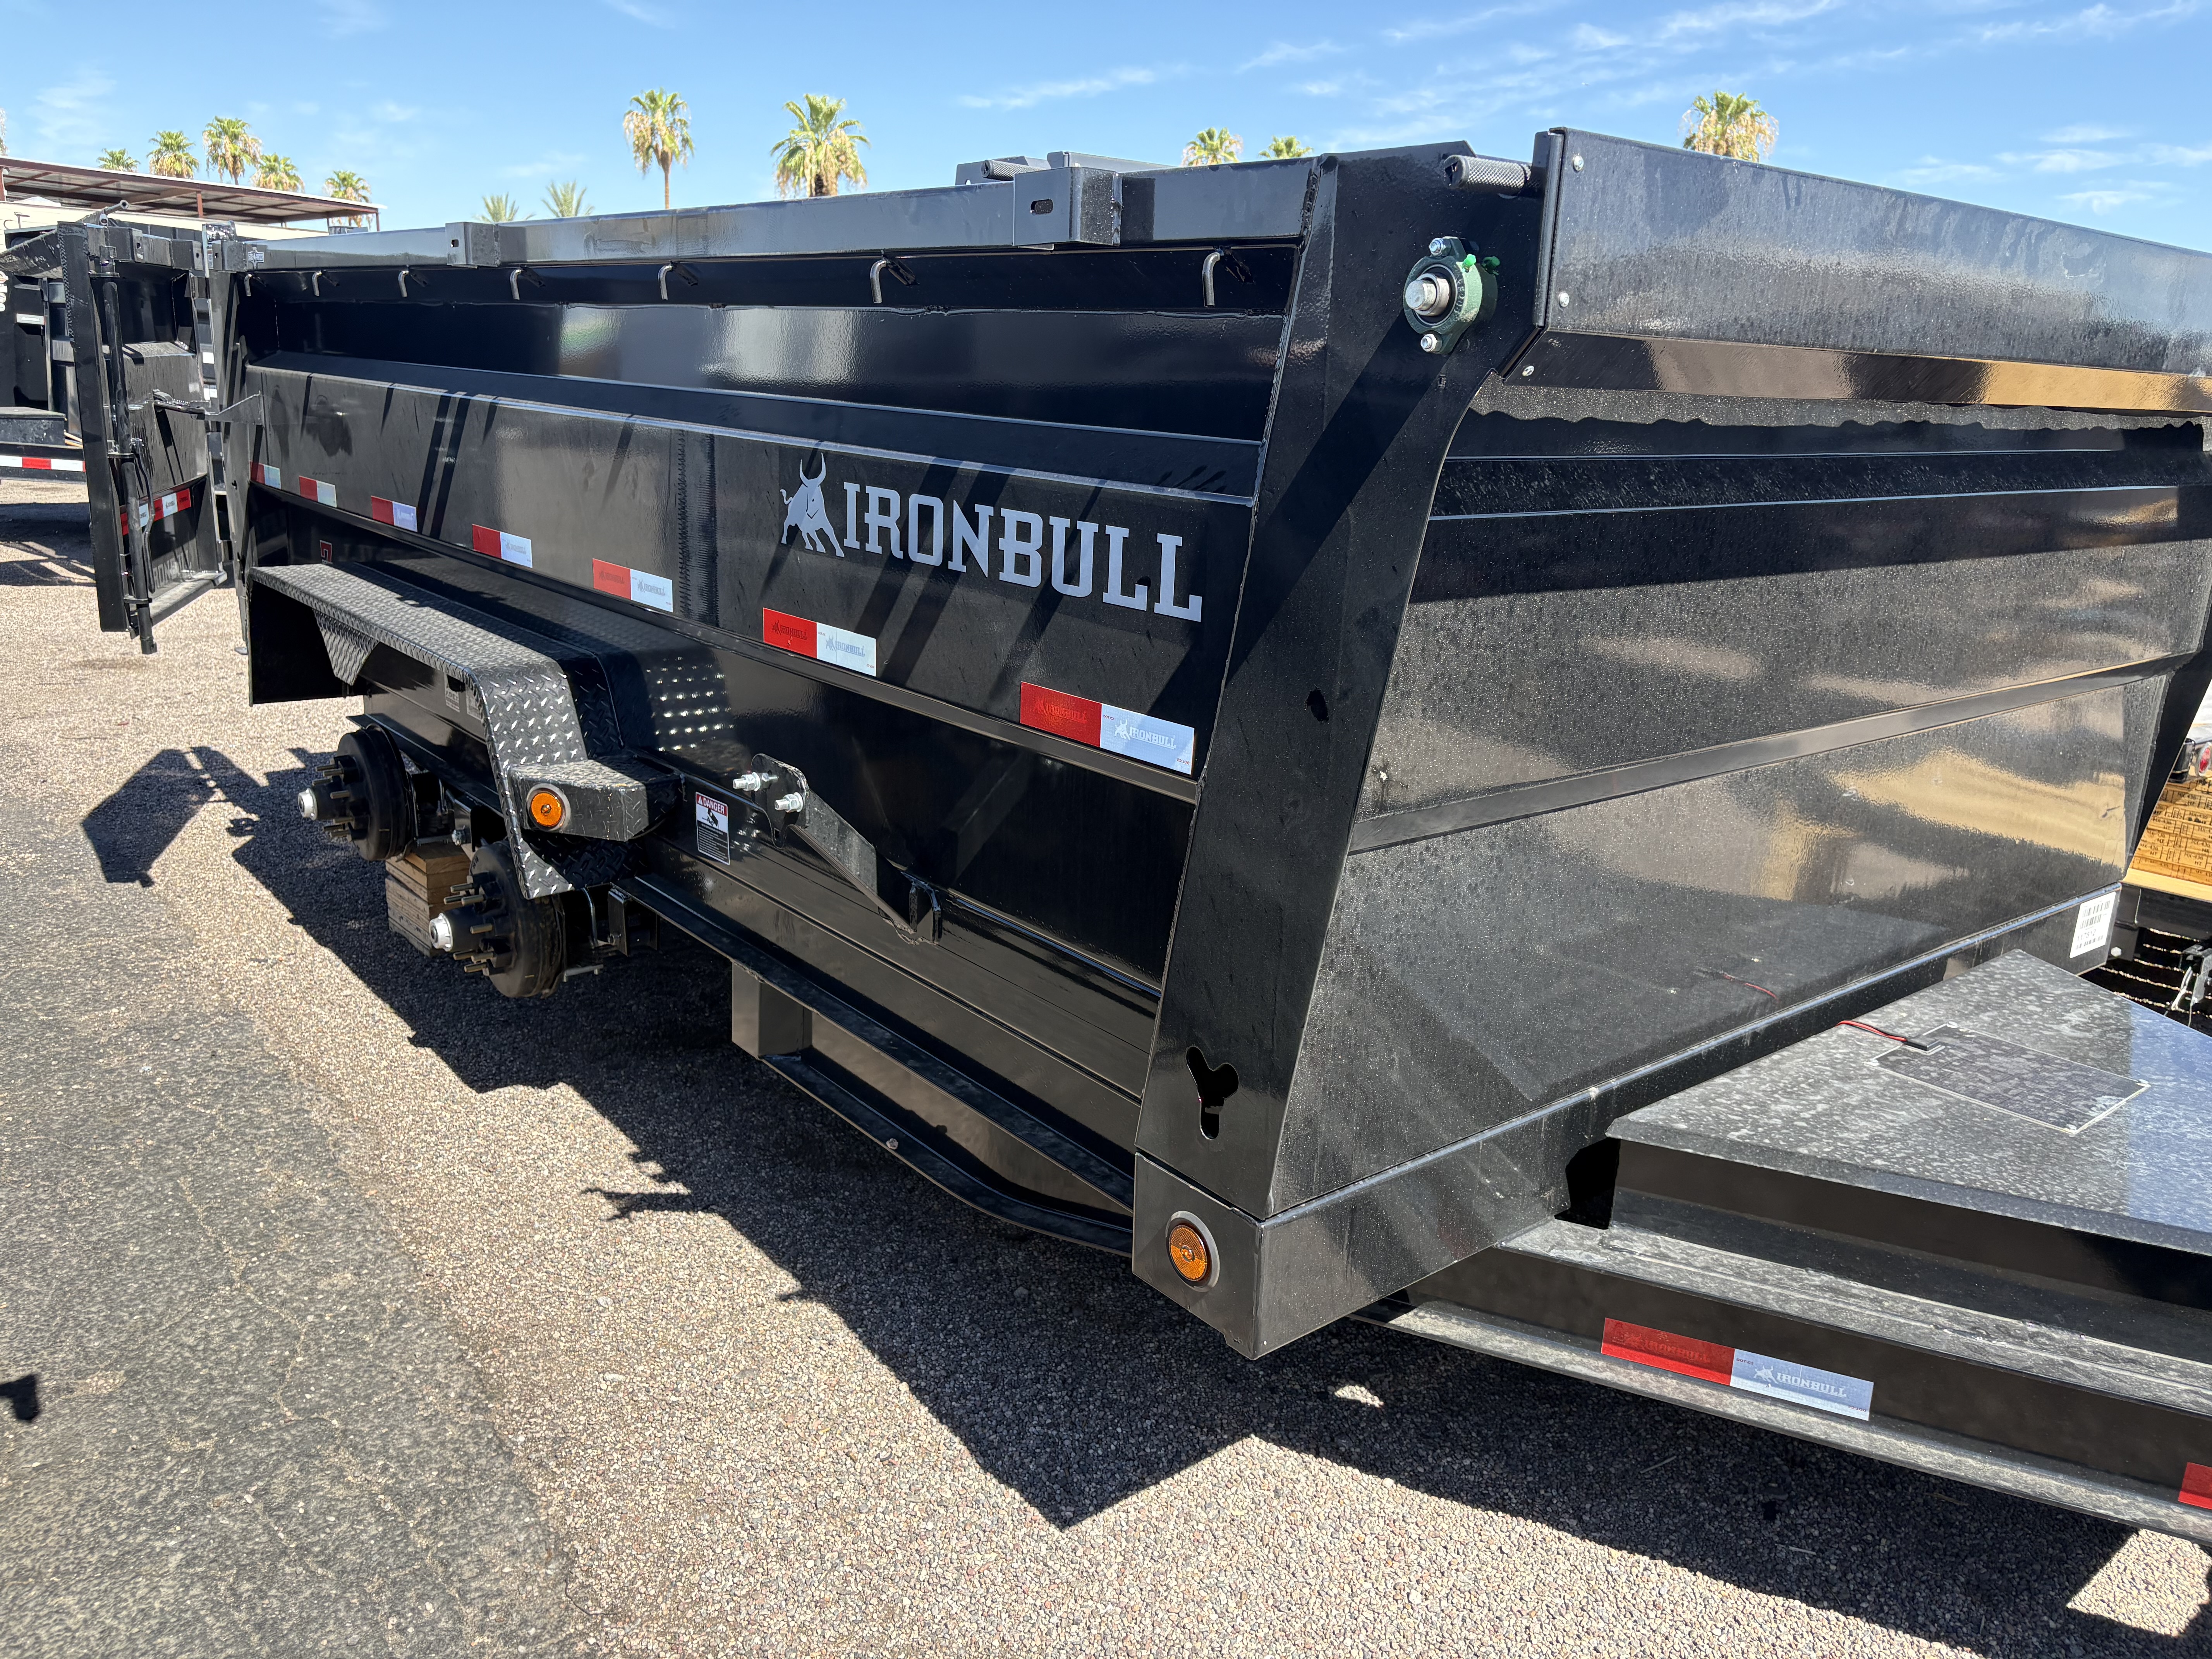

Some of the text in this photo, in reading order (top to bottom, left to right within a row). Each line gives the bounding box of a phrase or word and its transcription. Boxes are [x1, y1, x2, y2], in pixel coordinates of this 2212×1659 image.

[843, 482, 1202, 622] IRONBULL
[780, 624, 807, 640] IRONBULL
[835, 641, 865, 657] IRONBULL
[1045, 704, 1087, 723] IRONBULL
[1129, 726, 1176, 749] IRONBULL
[703, 797, 725, 814] DANGER
[1645, 1340, 1711, 1363] IRONBULL
[1776, 1372, 1847, 1398] IRONBULL
